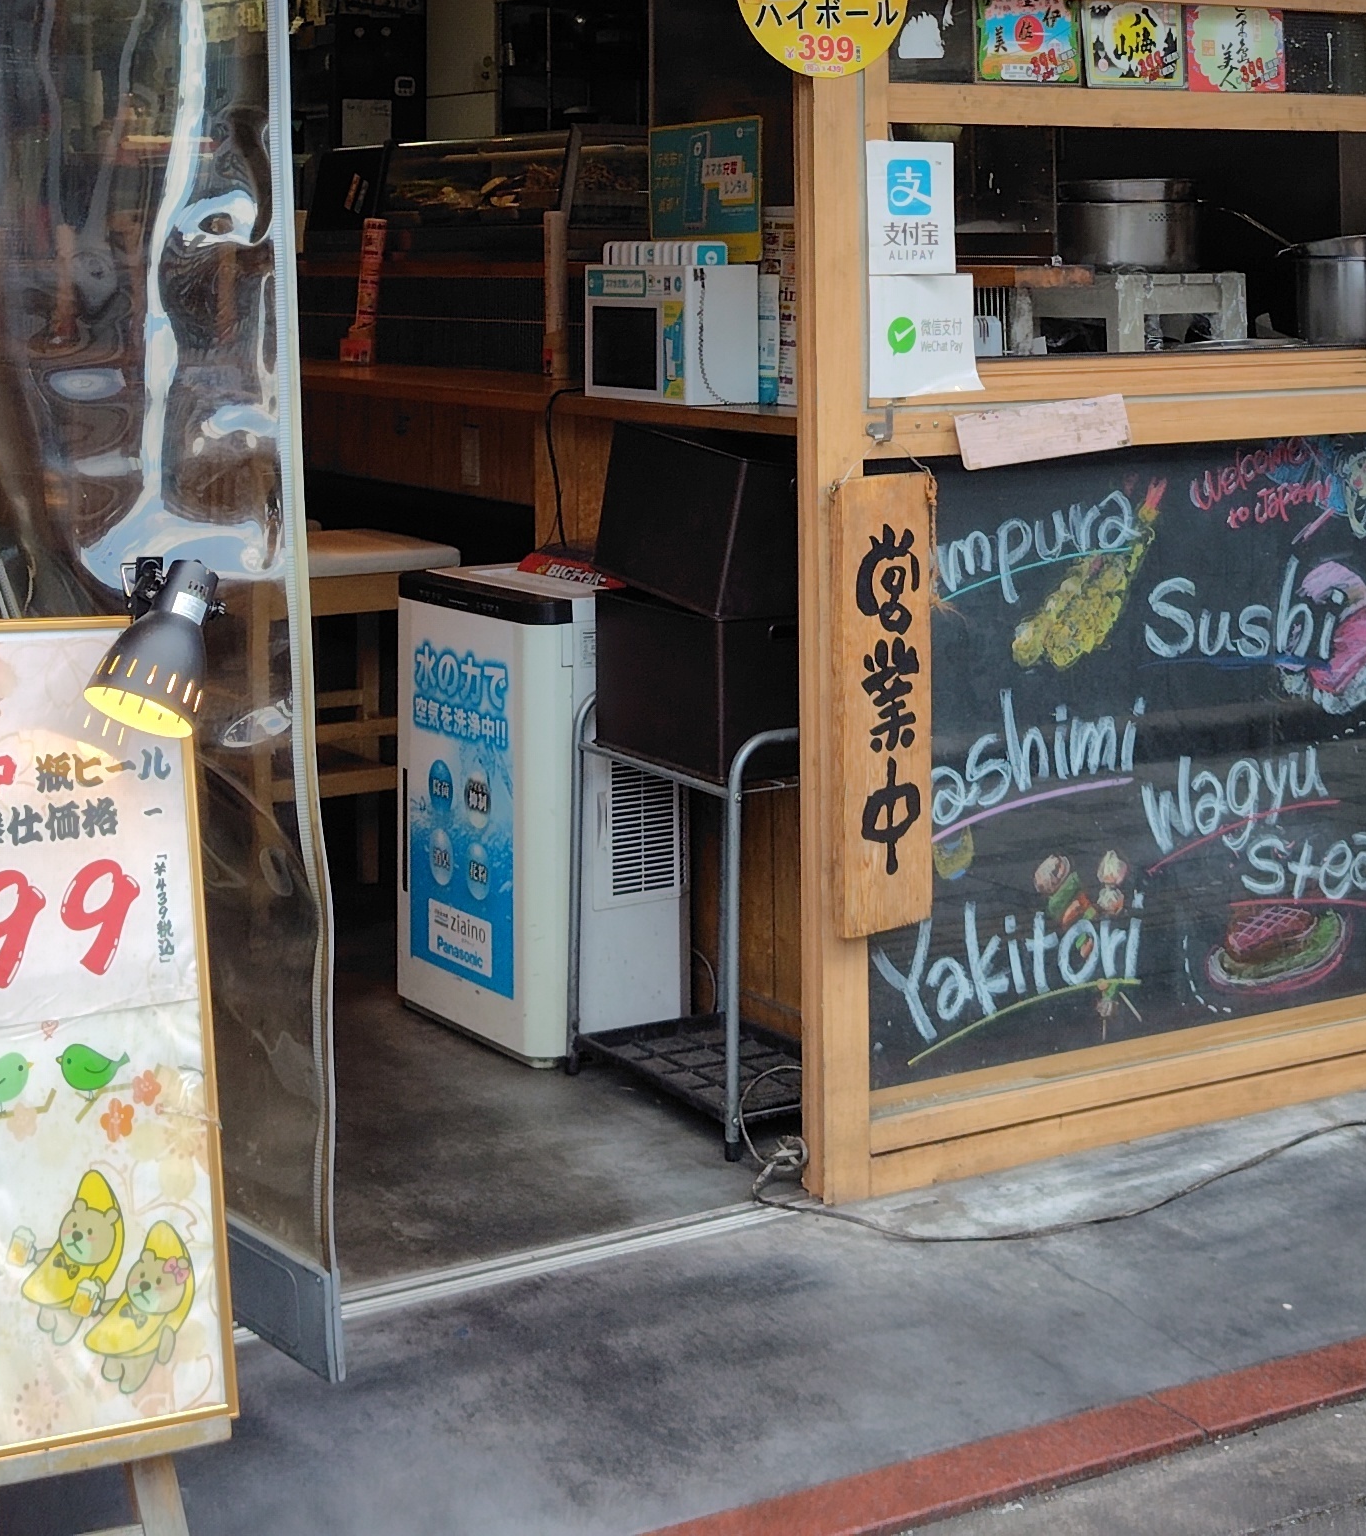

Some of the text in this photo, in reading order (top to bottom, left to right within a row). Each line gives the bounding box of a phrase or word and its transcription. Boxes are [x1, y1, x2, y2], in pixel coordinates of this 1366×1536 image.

[883, 221, 939, 246] 支付宝
[889, 250, 934, 260] ALIPAY
[921, 318, 962, 337] 微信支付
[921, 339, 963, 354] WeChat Pay
[1144, 556, 1344, 661] Sushi
[415, 645, 508, 709] 水の力で
[856, 524, 921, 876] 営業中
[35, 747, 171, 792] 瓶ビール
[1142, 743, 1329, 854] Wagyu
[450, 914, 486, 944] ziaino
[437, 934, 484, 969] Panasonic
[872, 891, 1146, 1041] Yakitori
